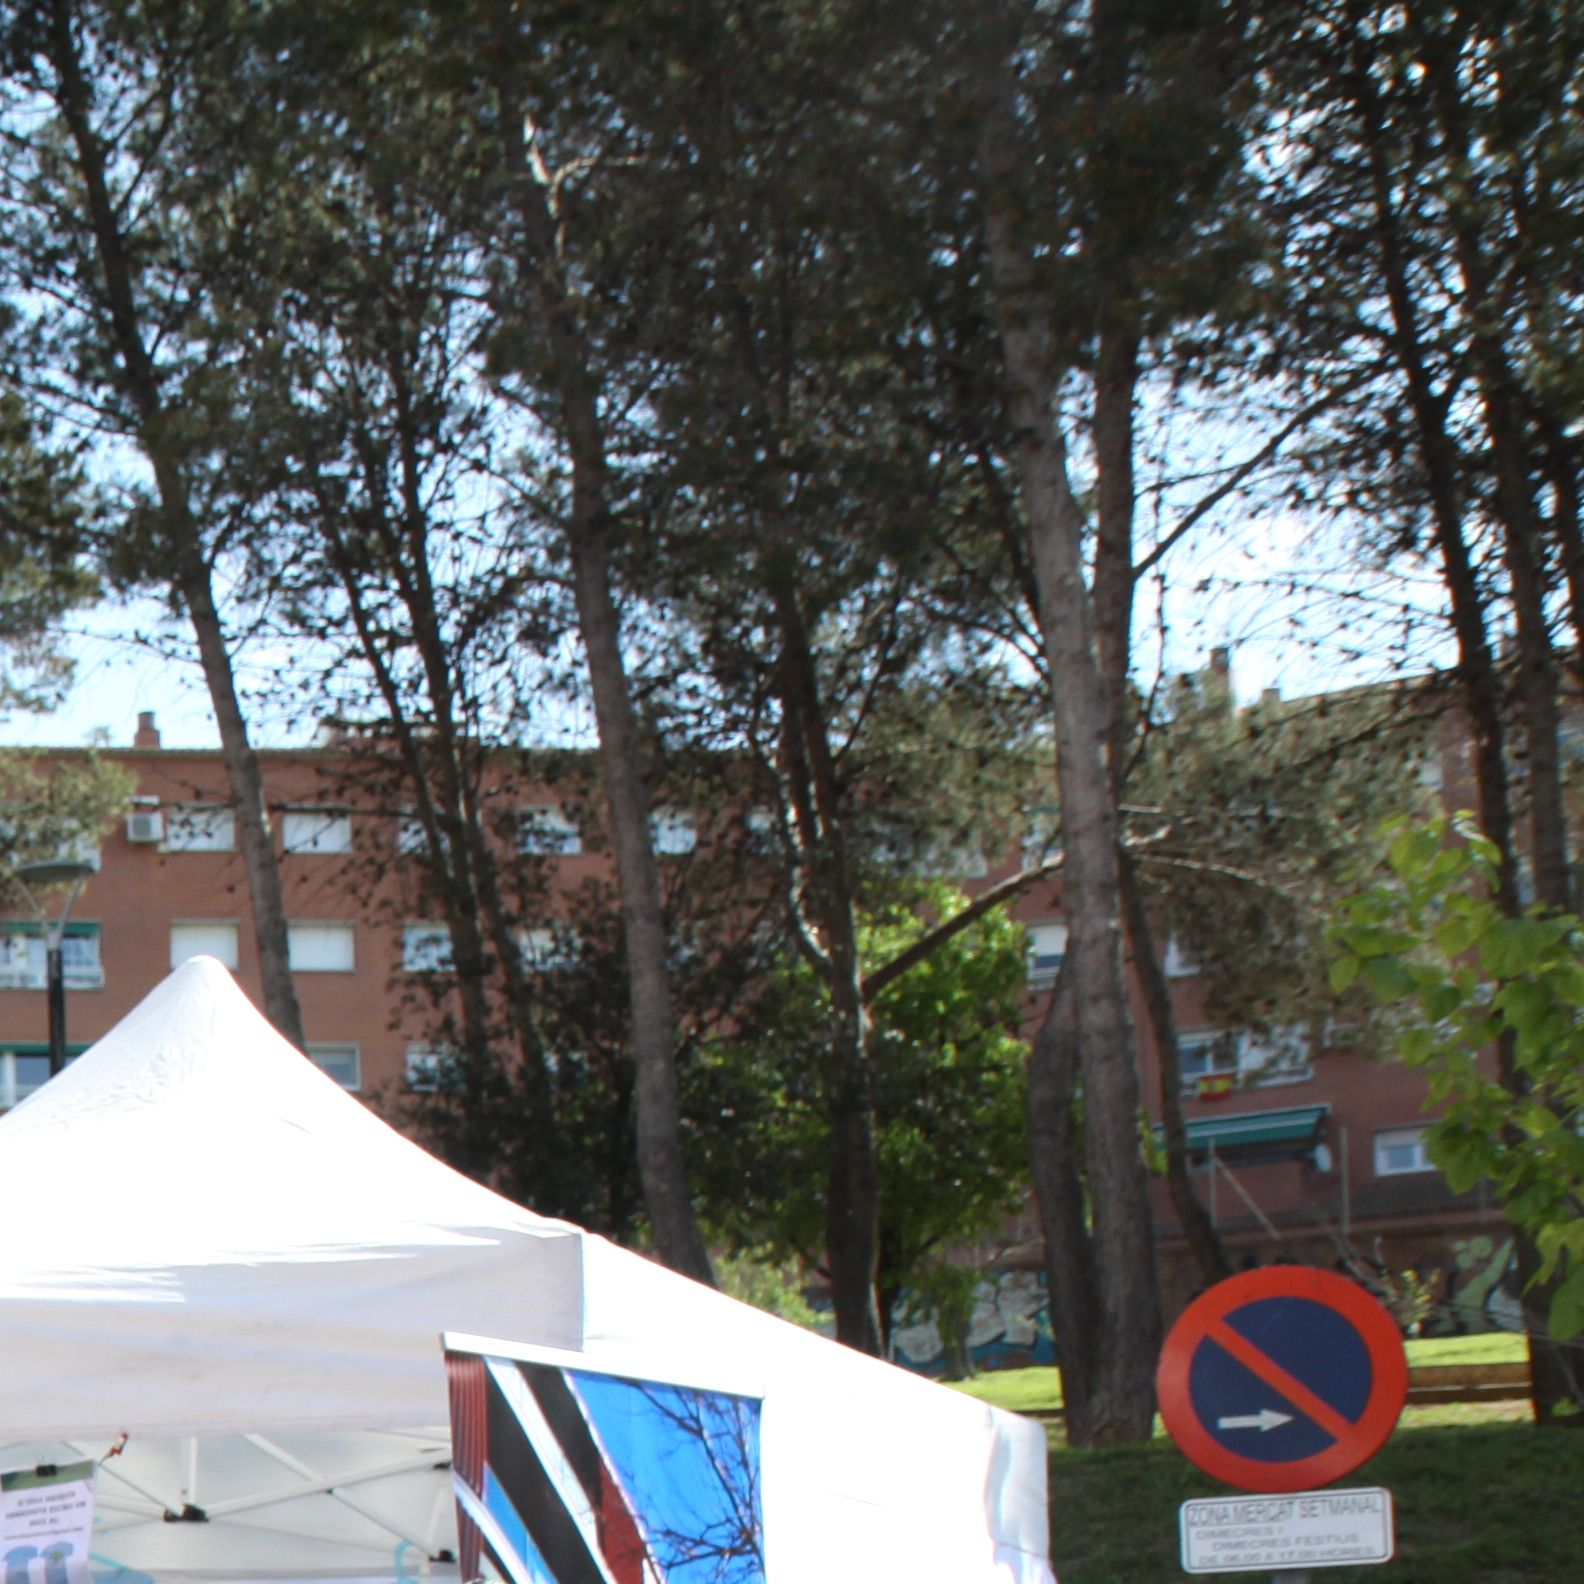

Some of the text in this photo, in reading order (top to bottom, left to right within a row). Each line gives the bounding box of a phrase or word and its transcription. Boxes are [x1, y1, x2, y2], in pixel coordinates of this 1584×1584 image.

[1189, 1494, 1383, 1527] ZONA MERCAT SETMANAL
